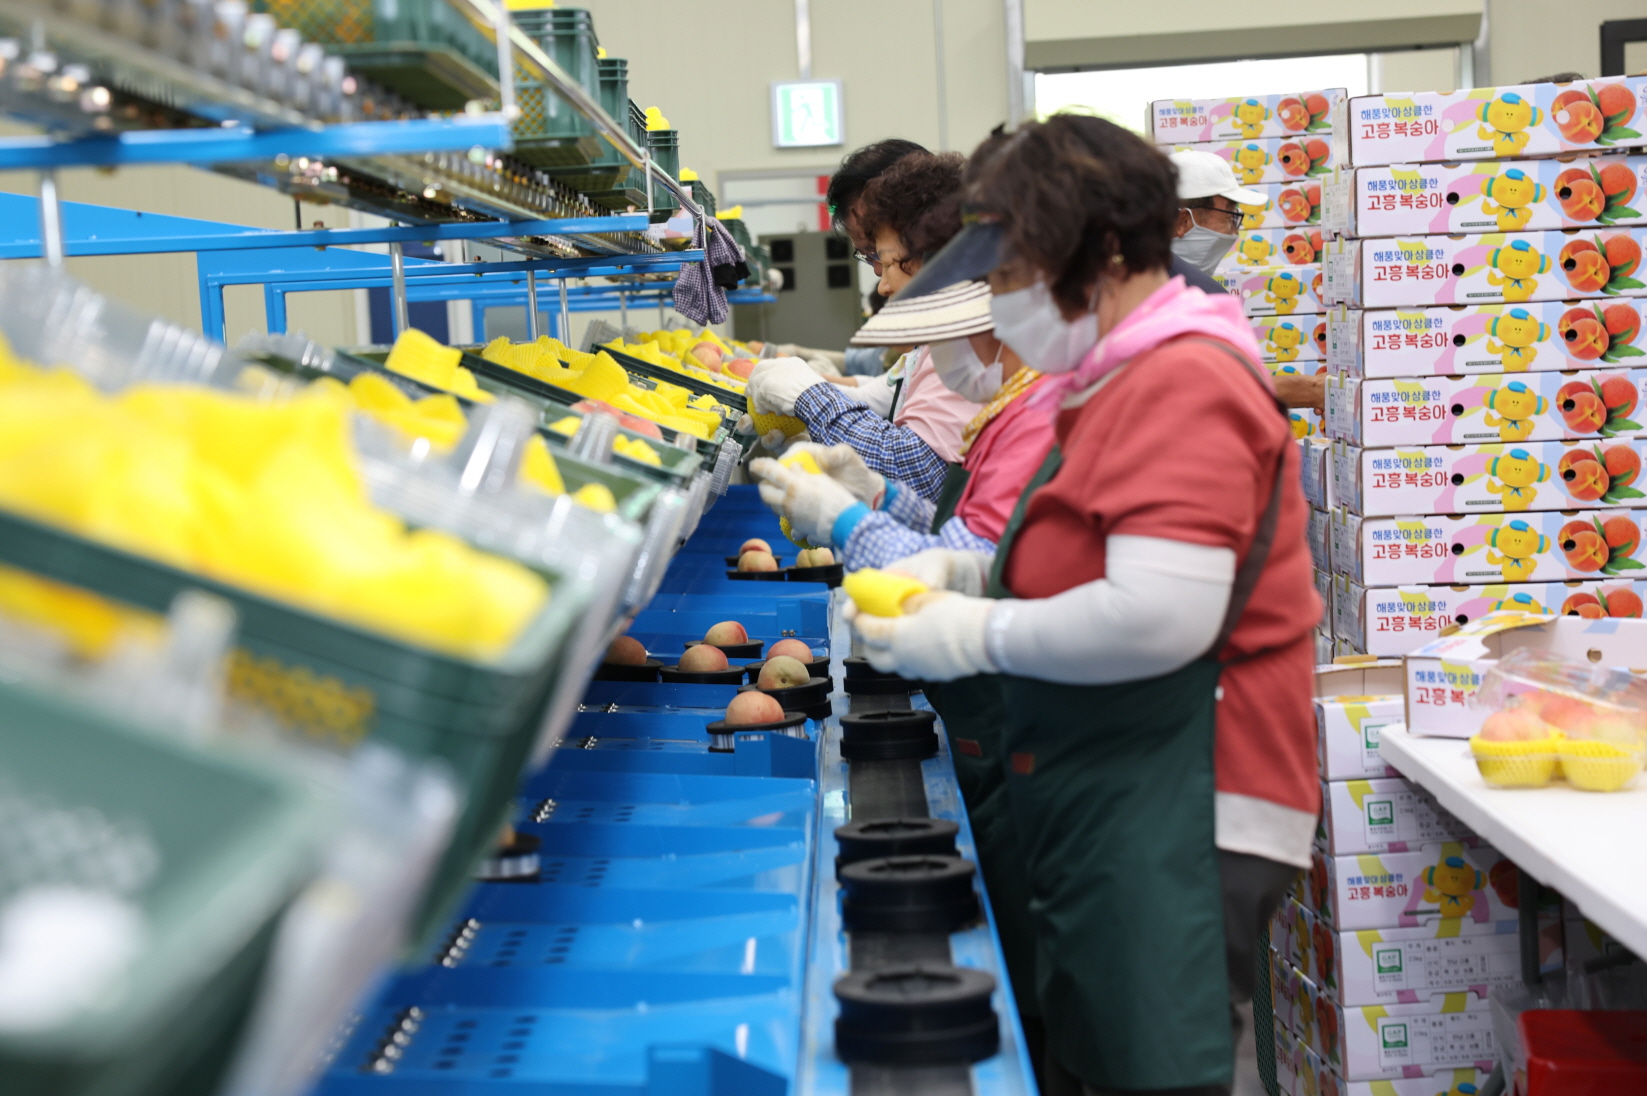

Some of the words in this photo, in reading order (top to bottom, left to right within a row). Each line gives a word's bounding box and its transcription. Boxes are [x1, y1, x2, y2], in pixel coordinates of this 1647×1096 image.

[1361, 107, 1401, 121] 해풍맞아
[1403, 104, 1433, 118] 상큼한
[1361, 122, 1392, 140] 고흥
[1394, 119, 1439, 138] 복숭아
[1367, 179, 1407, 192] 해풍맞아
[1409, 178, 1439, 190] 상큼한
[1367, 194, 1397, 211] 고흥
[1399, 193, 1444, 210] 복숭아
[1373, 250, 1413, 262] 해풍맞아
[1415, 249, 1445, 261] 상큼한
[1373, 264, 1403, 281] 고흥
[1405, 263, 1450, 280] 복숭아
[1372, 319, 1412, 331] 해풍맞아
[1413, 317, 1443, 330] 상큼한
[1372, 333, 1402, 350] 고흥
[1404, 332, 1449, 349] 복숭아
[1371, 391, 1410, 404] 해풍맞아
[1412, 389, 1441, 402] 상큼한
[1371, 405, 1400, 422] 고흥
[1402, 404, 1447, 421] 복숭아
[1372, 458, 1412, 470] 해풍맞아
[1413, 456, 1443, 469] 상큼한
[1372, 472, 1402, 488] 고흥
[1404, 471, 1449, 487] 복숭아
[1372, 528, 1412, 541] 해풍맞아
[1413, 527, 1443, 540] 상큼한
[1372, 543, 1402, 559] 고흥
[1404, 542, 1449, 558] 복숭아
[1376, 602, 1416, 613] 해풍맞아
[1417, 600, 1447, 612] 상큼한
[1376, 615, 1405, 632] 고흥
[1408, 614, 1453, 631] 복숭아
[1416, 687, 1447, 707] 고흥
[1348, 886, 1371, 901] 고흥
[1373, 884, 1409, 899] 복숭아
